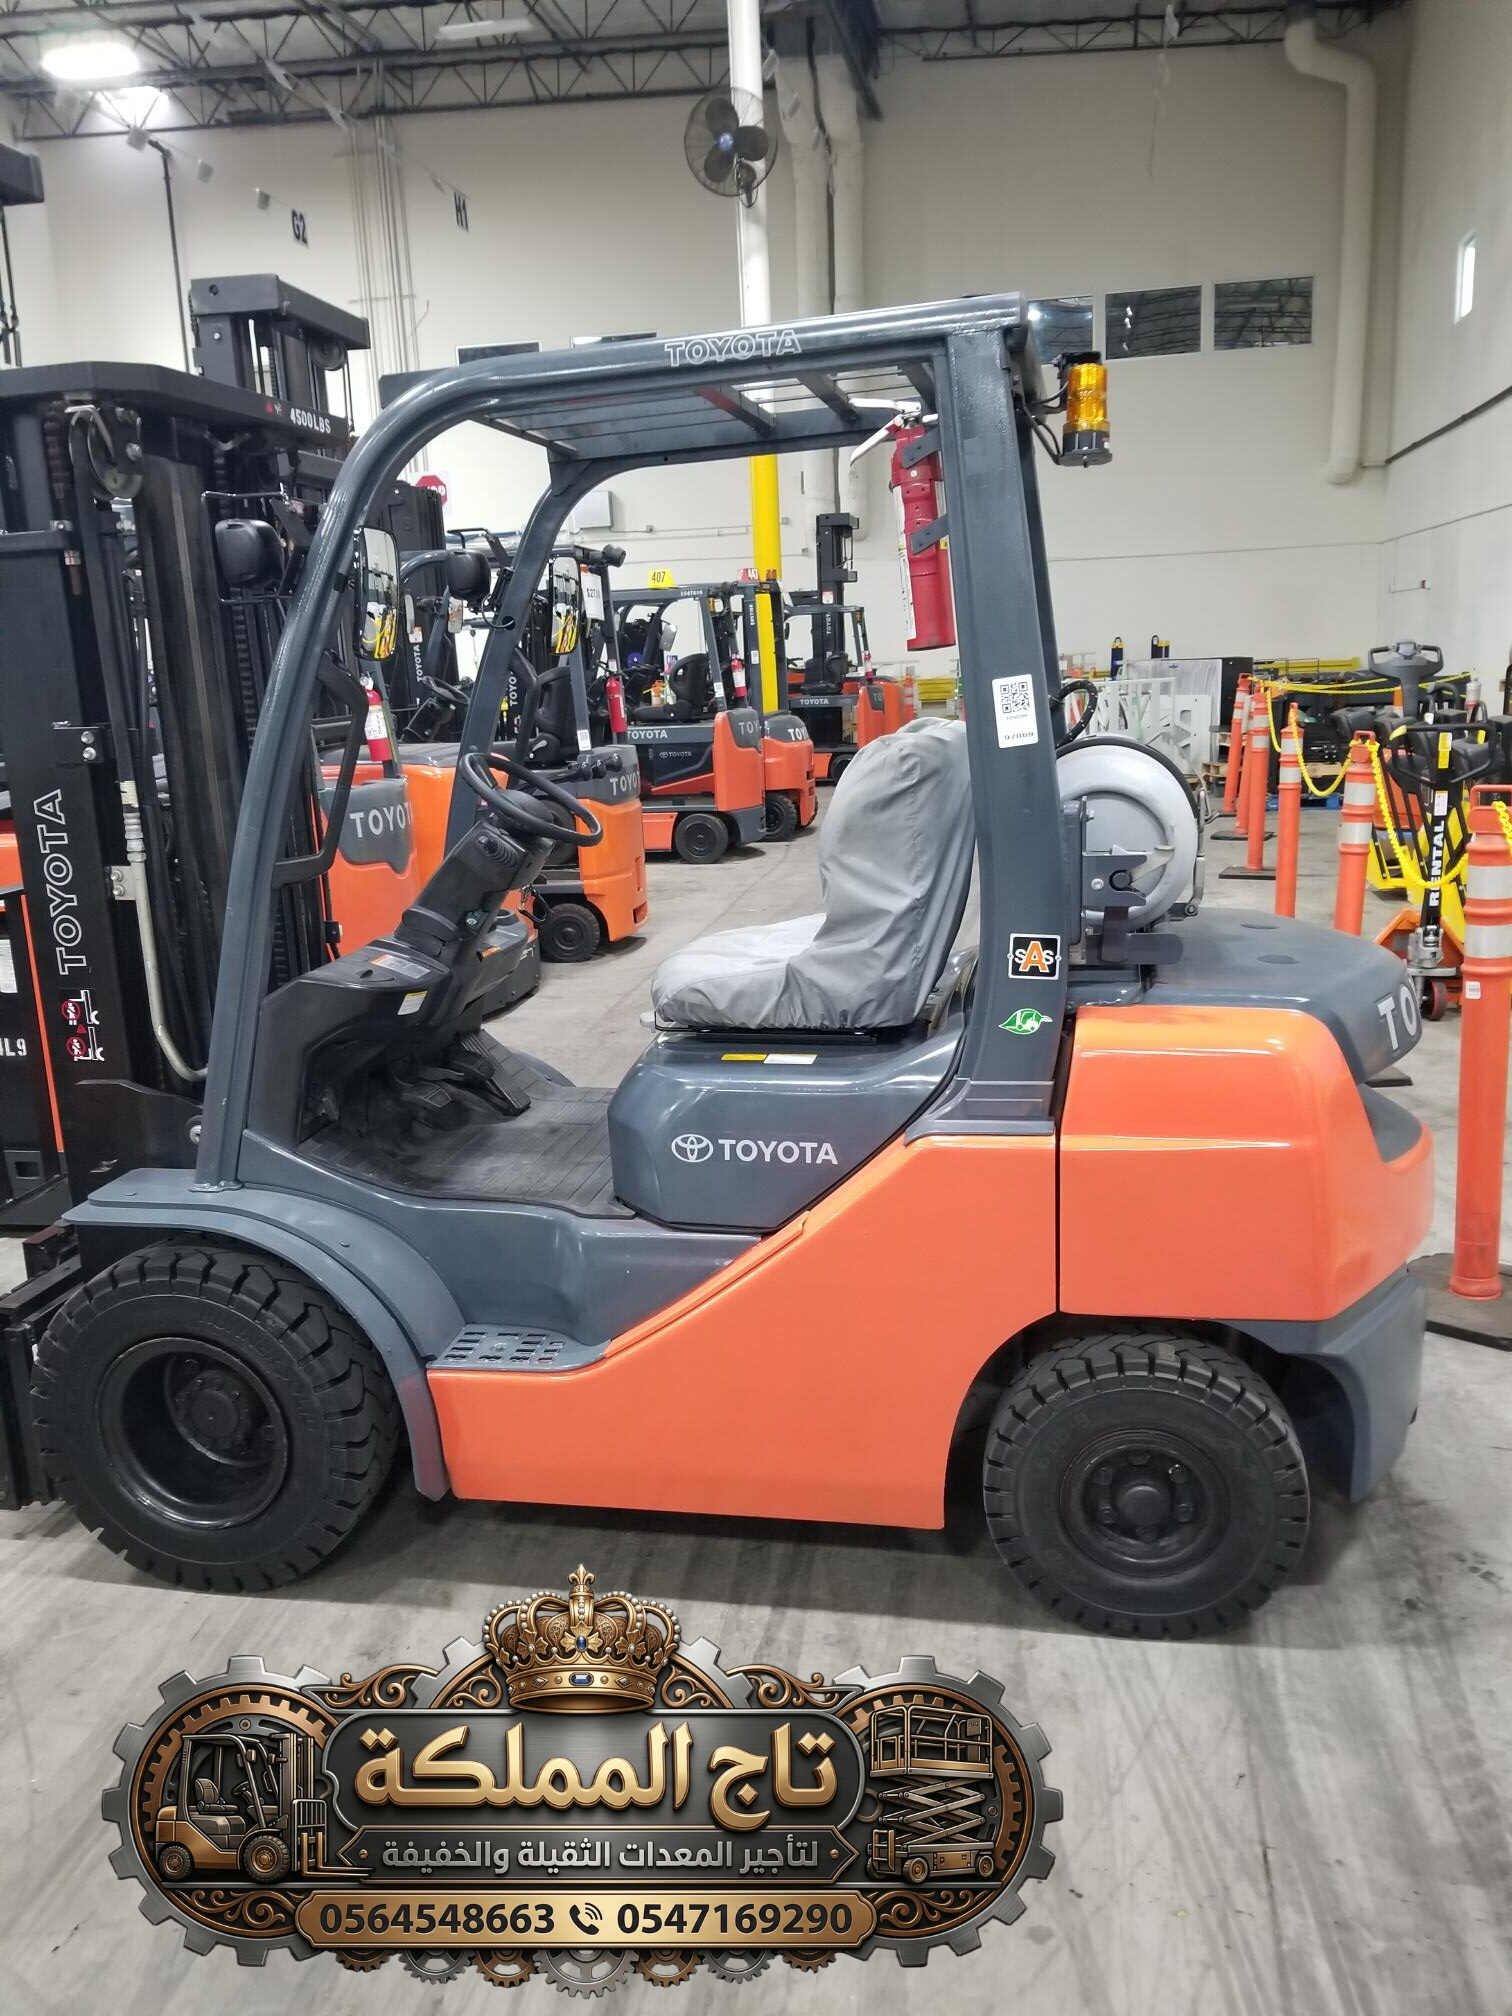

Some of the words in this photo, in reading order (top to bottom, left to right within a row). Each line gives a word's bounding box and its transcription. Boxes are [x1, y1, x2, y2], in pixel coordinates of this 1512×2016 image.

[291, 209, 308, 246] G2
[453, 191, 469, 231] H1
[664, 329, 802, 367] TOYOTA
[290, 407, 331, 434] 4500LBS
[651, 571, 666, 584] 407
[413, 644, 424, 682] TOYOTA
[34, 788, 87, 976] TOYOTA
[1428, 819, 1446, 907] RENTAL
[718, 1138, 839, 1165] TOYOTA
